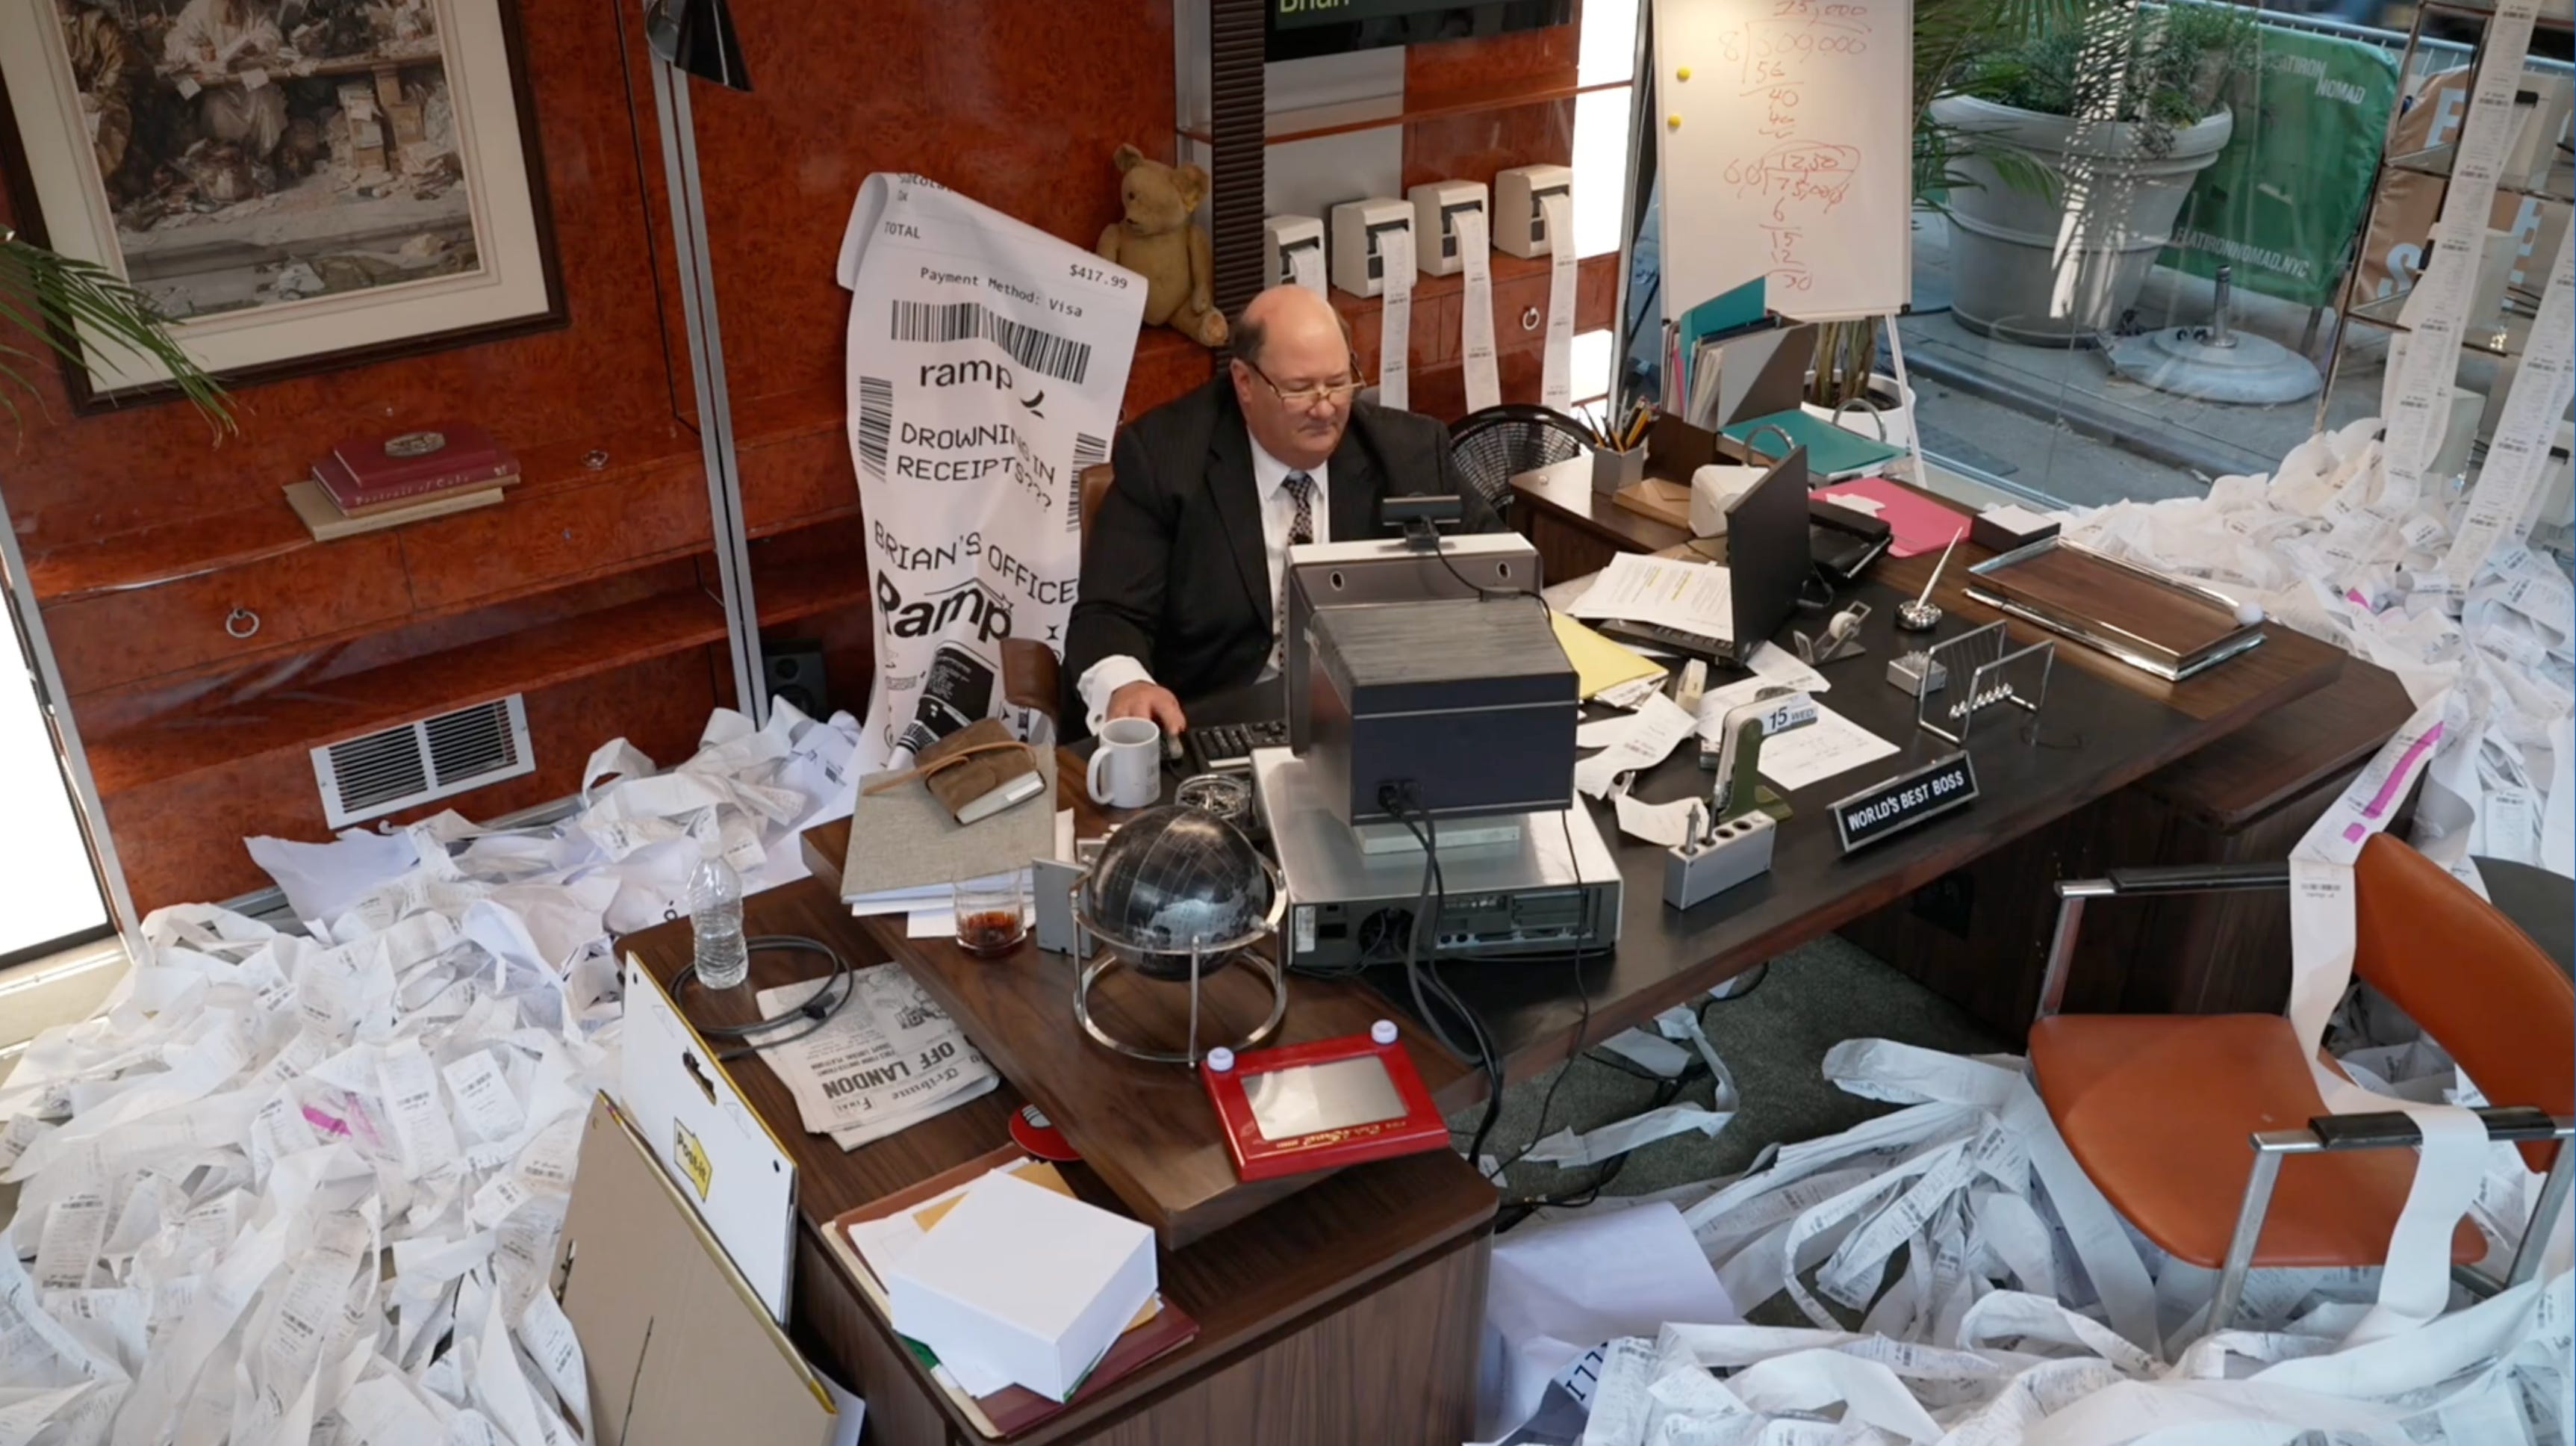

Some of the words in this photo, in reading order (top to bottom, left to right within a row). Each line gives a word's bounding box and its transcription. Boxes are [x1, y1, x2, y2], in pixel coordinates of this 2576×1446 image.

[2315, 75, 2366, 105] NOMAD
[884, 221, 921, 239] TOTAL
[920, 267, 979, 287] Payment
[988, 277, 1040, 305] Method:
[1048, 298, 1083, 317] Visa
[1069, 263, 1128, 290] $417.99
[919, 359, 1013, 390] ramp
[900, 423, 1030, 462] DROWNING
[1033, 454, 1055, 485] IN
[897, 455, 1052, 513] RECEIPTS???
[874, 520, 983, 571] BRIAN'S
[988, 545, 1077, 605] OFFICE
[876, 569, 1012, 643] Ramp
[1769, 706, 1788, 730] 15
[1791, 707, 1814, 720] WED
[1847, 796, 1900, 831] WORLD'S
[1900, 783, 1929, 810] BEST
[1932, 770, 1964, 796] BOSS
[919, 1041, 955, 1070] OFF
[822, 1060, 910, 1099] LANDON
[892, 1067, 959, 1100] Tribune
